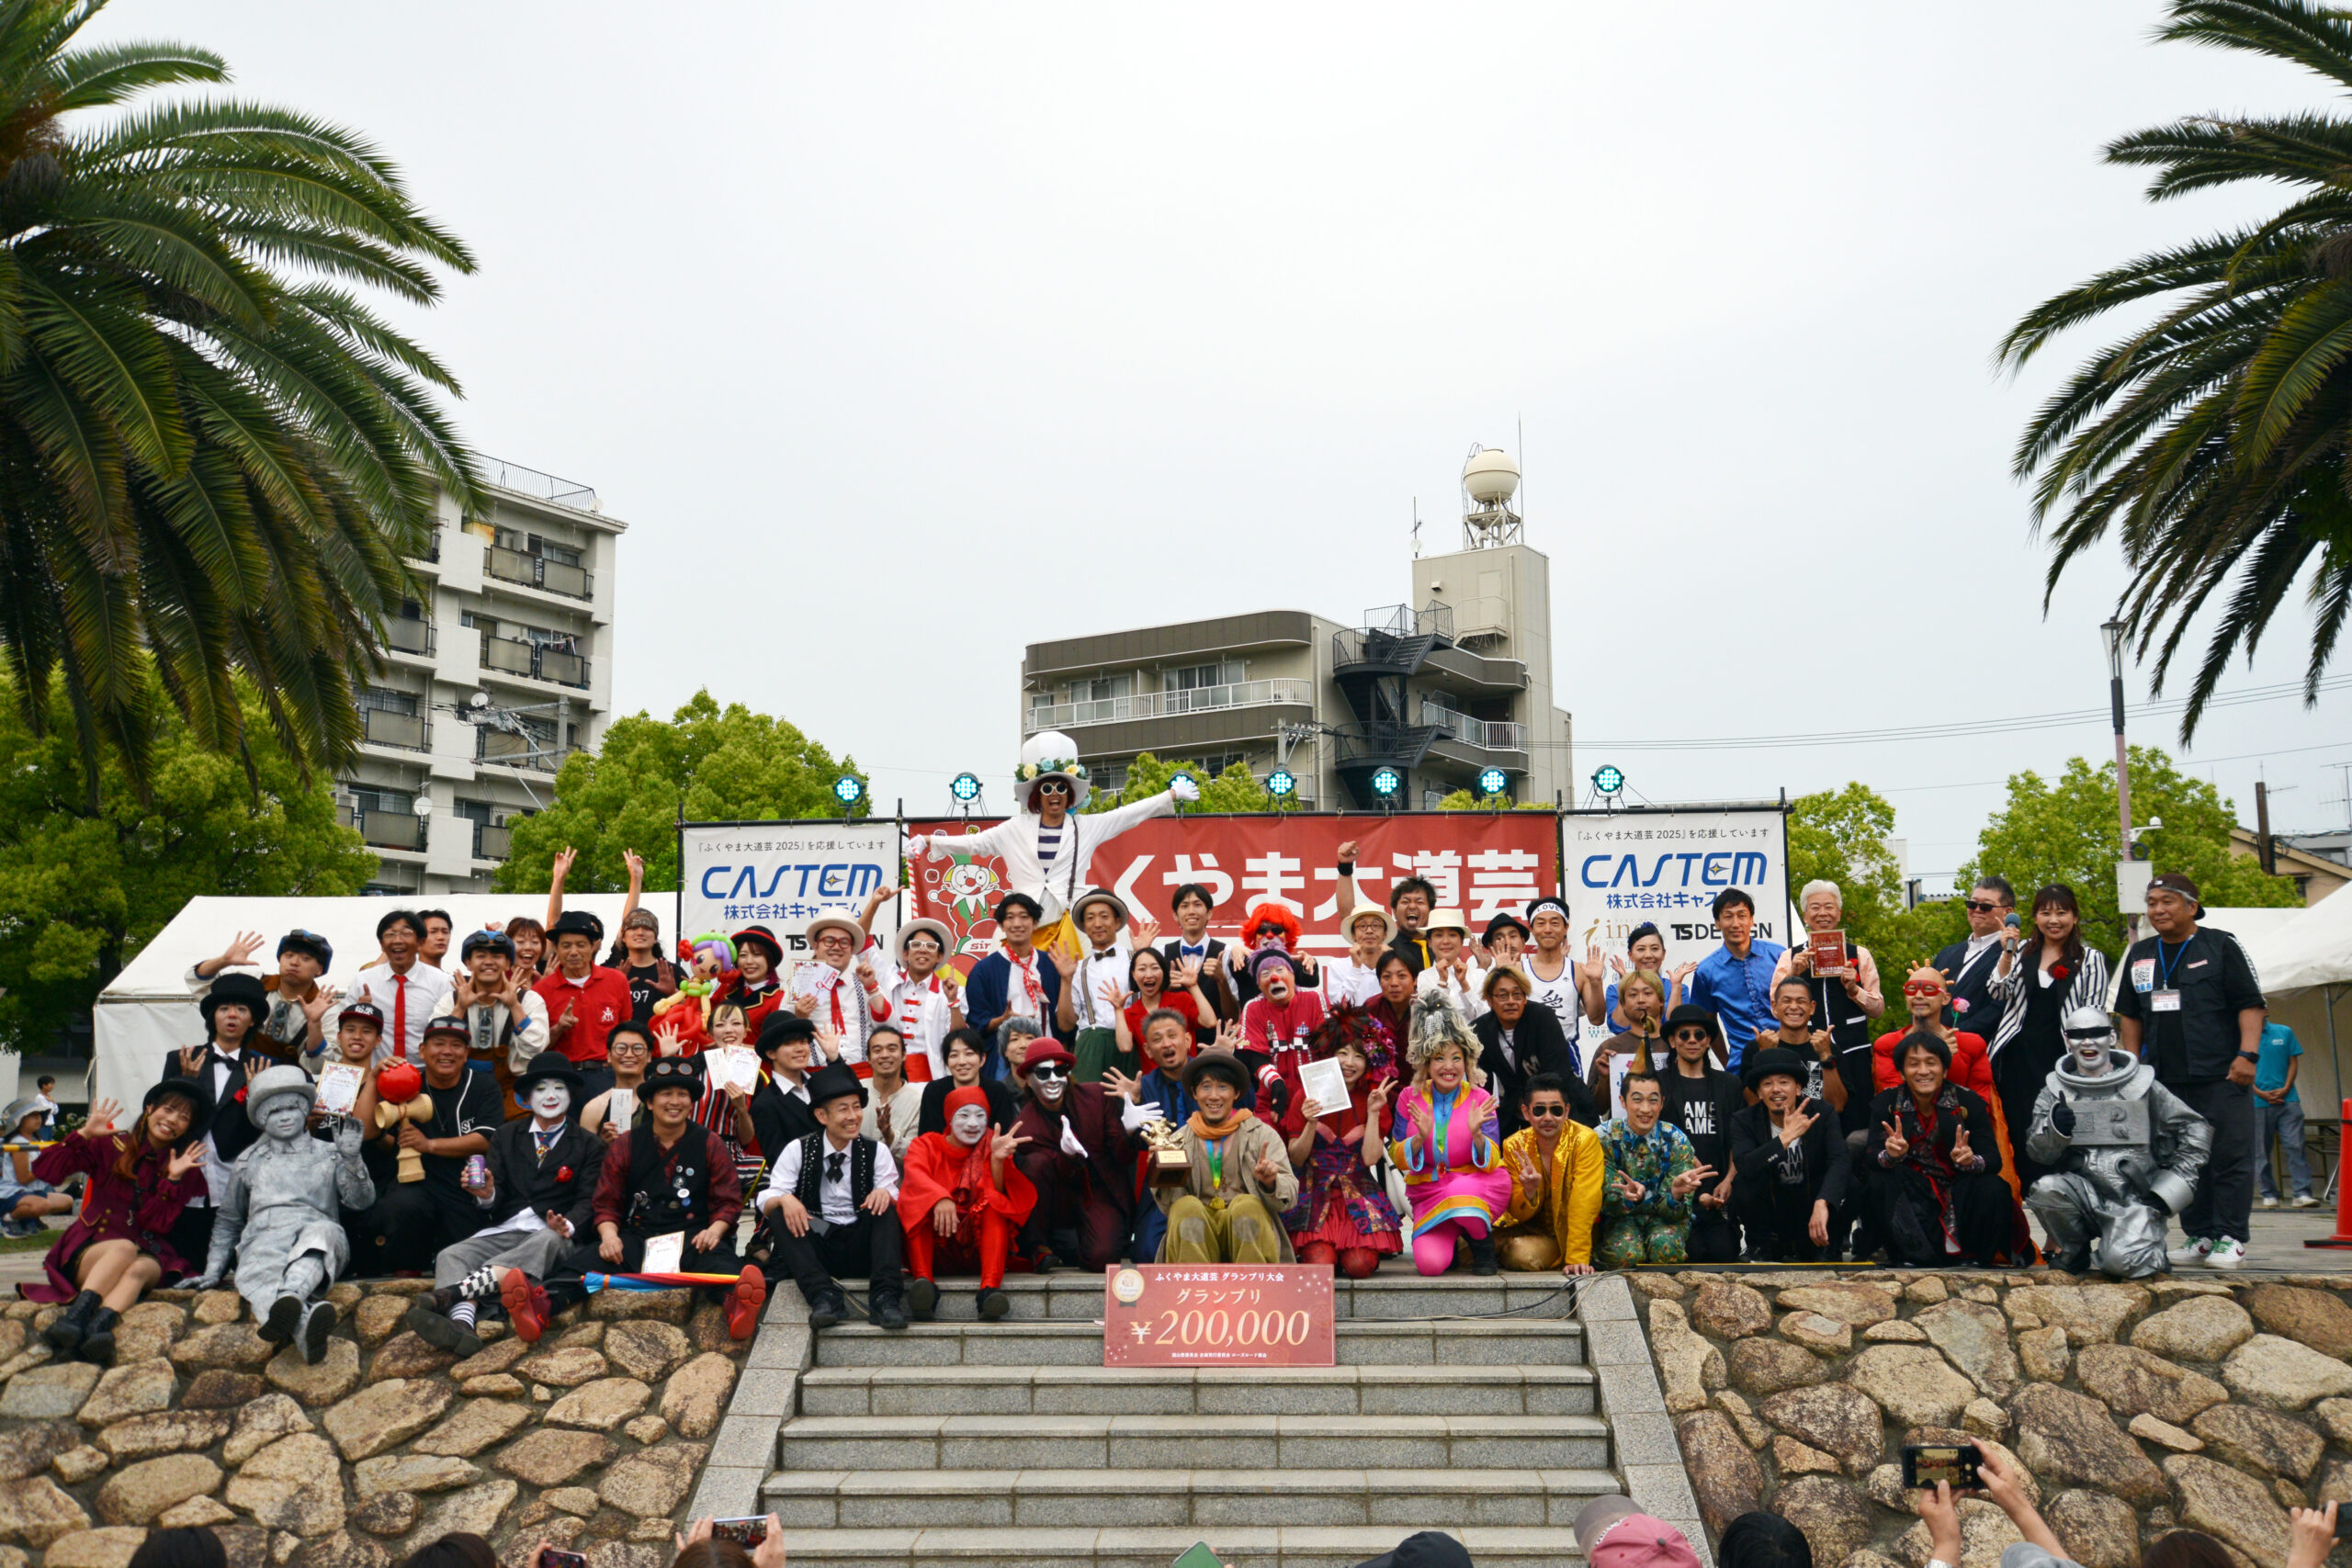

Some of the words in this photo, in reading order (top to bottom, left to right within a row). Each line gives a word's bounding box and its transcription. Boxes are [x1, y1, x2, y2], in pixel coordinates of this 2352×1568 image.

[1581, 852, 1768, 888] CASTEM
[701, 863, 883, 899] CASTEM
[1537, 903, 1560, 912] LOVE
[1685, 1117, 1717, 1134] AME
[1155, 1272, 1218, 1281] ふくやま大道芸
[1221, 1271, 1284, 1281] グランプリ大会
[1176, 1288, 1261, 1305] グランプリ
